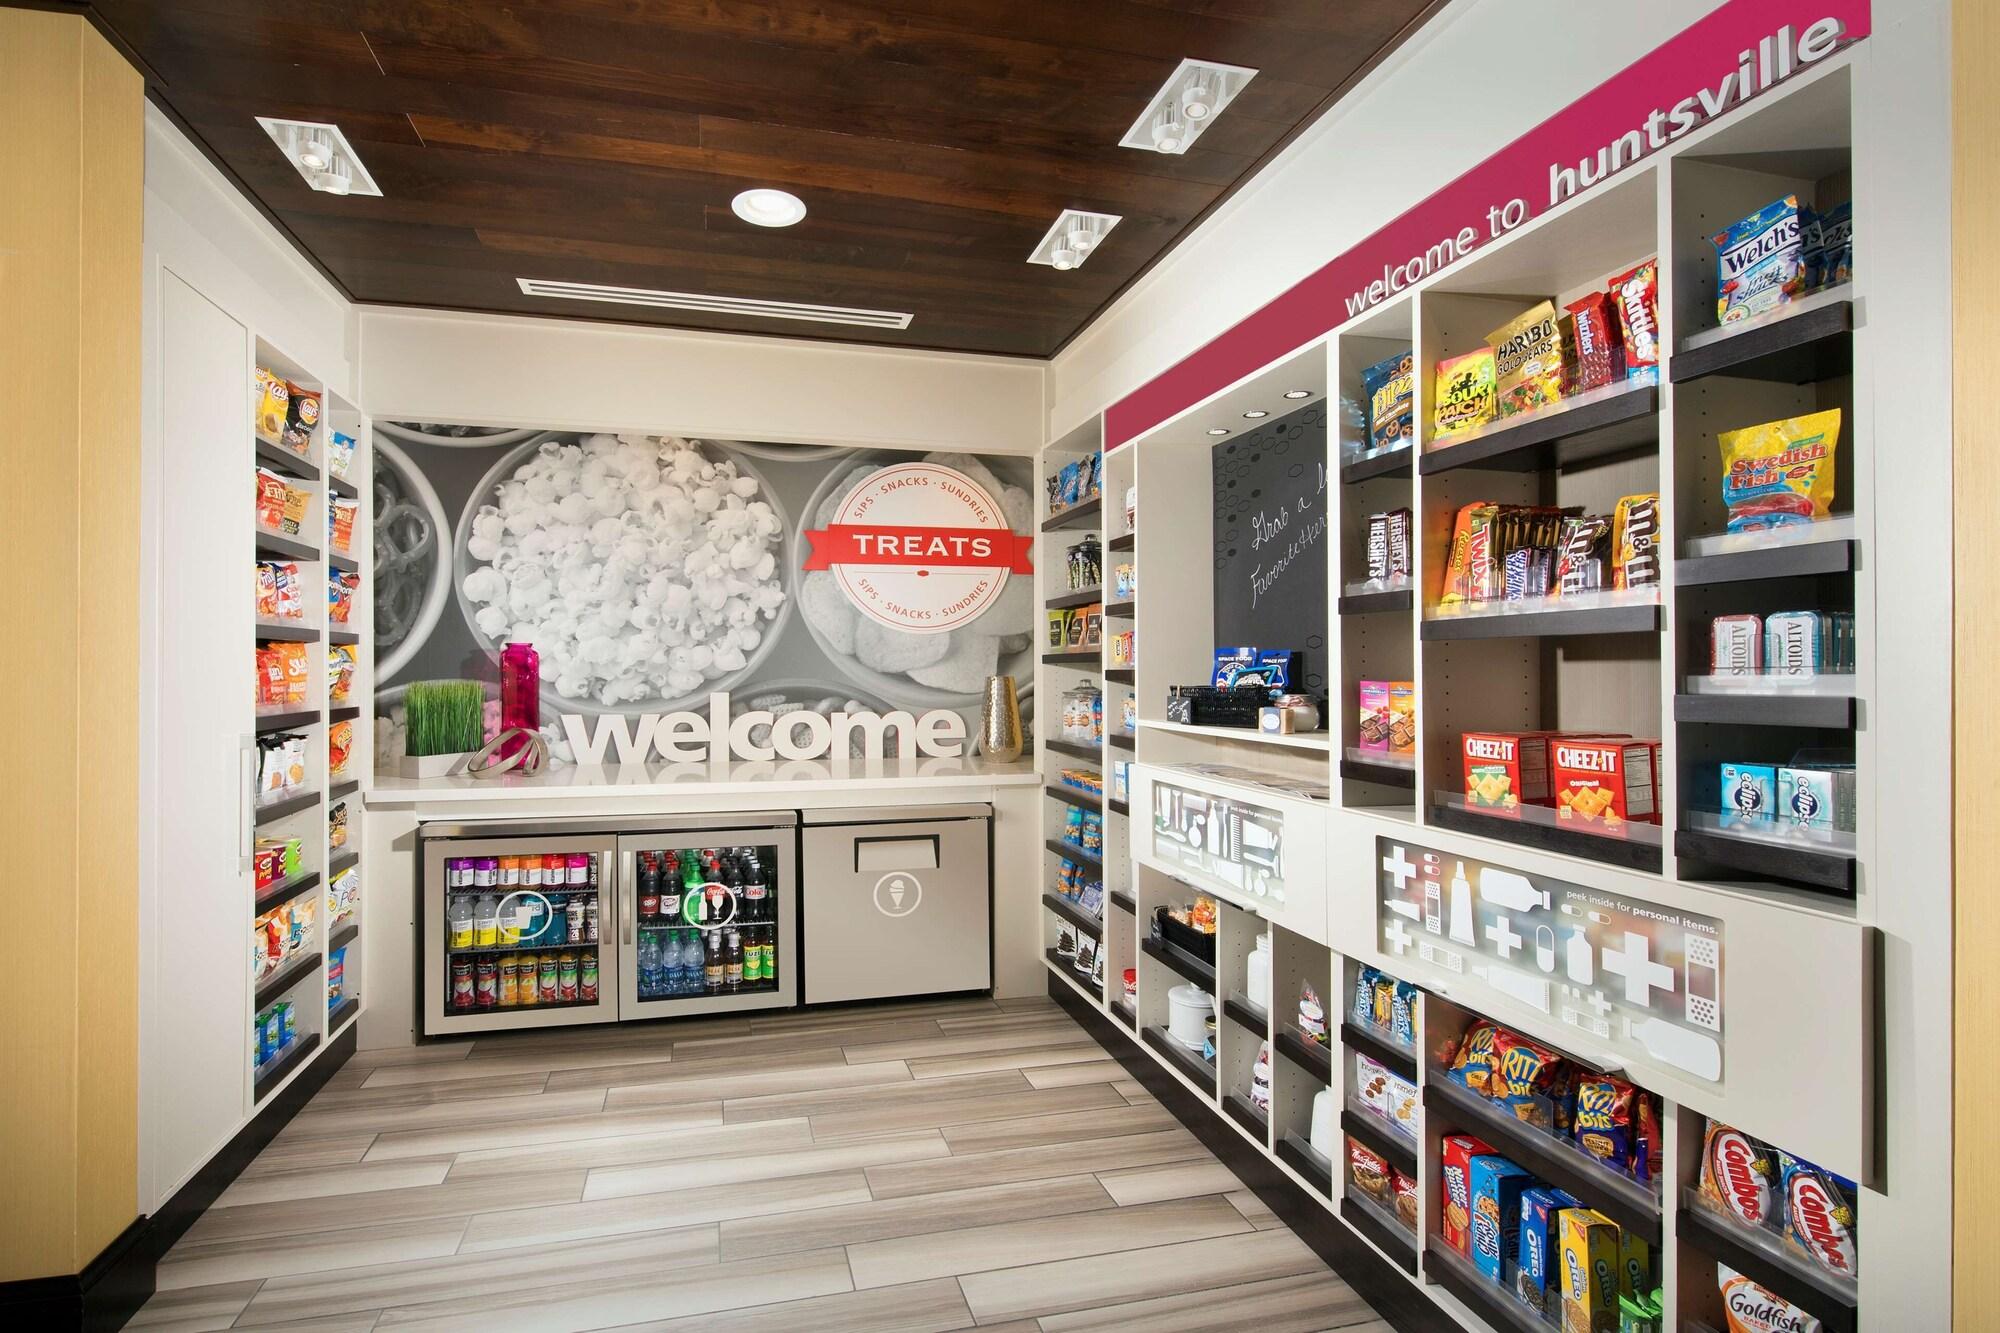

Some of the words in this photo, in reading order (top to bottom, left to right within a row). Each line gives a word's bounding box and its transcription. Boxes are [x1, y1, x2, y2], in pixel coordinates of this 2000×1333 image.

[1344, 224, 1477, 318] welcome
[1486, 198, 1529, 238] to
[1549, 16, 1846, 206] huntsville
[1725, 221, 1799, 273] Welch's
[1497, 319, 1552, 361] HARIBO
[1575, 308, 1592, 355] Twizzlers
[1621, 278, 1655, 359] Skittles
[1439, 397, 1487, 421] PATCH
[1443, 384, 1489, 406] SOUR
[1730, 470, 1779, 490] Fish
[1731, 443, 1828, 475] Swedish
[854, 496, 874, 519] SIPS
[880, 477, 929, 494] SNACKS
[941, 481, 989, 524] SUNDRIES
[1251, 506, 1289, 550] Grab
[1297, 496, 1312, 513] a
[852, 534, 993, 558] TREATS
[1368, 521, 1386, 579] HERSHEY'S
[1471, 524, 1490, 587] TWIX
[858, 578, 879, 600] SIPS
[885, 602, 932, 620] SNACKS
[942, 580, 988, 617] SUNDRIES
[1732, 625, 1746, 676] ALTOIDS
[1788, 622, 1803, 676] ALTOIDS
[560, 692, 967, 764] welcome
[1466, 738, 1515, 761] CHEEZ-IT
[1556, 747, 1617, 772] CHEEZ-IT
[1740, 772, 1753, 824] eclipse
[1797, 776, 1810, 831] eclipse
[1566, 891, 1587, 902] peek
[1589, 894, 1615, 909] inside
[1616, 901, 1631, 913] for
[1633, 907, 1680, 925] personal
[1683, 917, 1719, 935] items.
[1579, 1111, 1612, 1129] bits
[1445, 1166, 1461, 1208] Butter
[1452, 1165, 1468, 1208] Nutter
[1725, 1139, 1762, 1221] Combos
[1799, 1184, 1849, 1273] Combos
[1527, 1228, 1539, 1277] OREO
[1565, 1247, 1582, 1300] OREO
[1729, 1293, 1802, 1333] Goldfish
